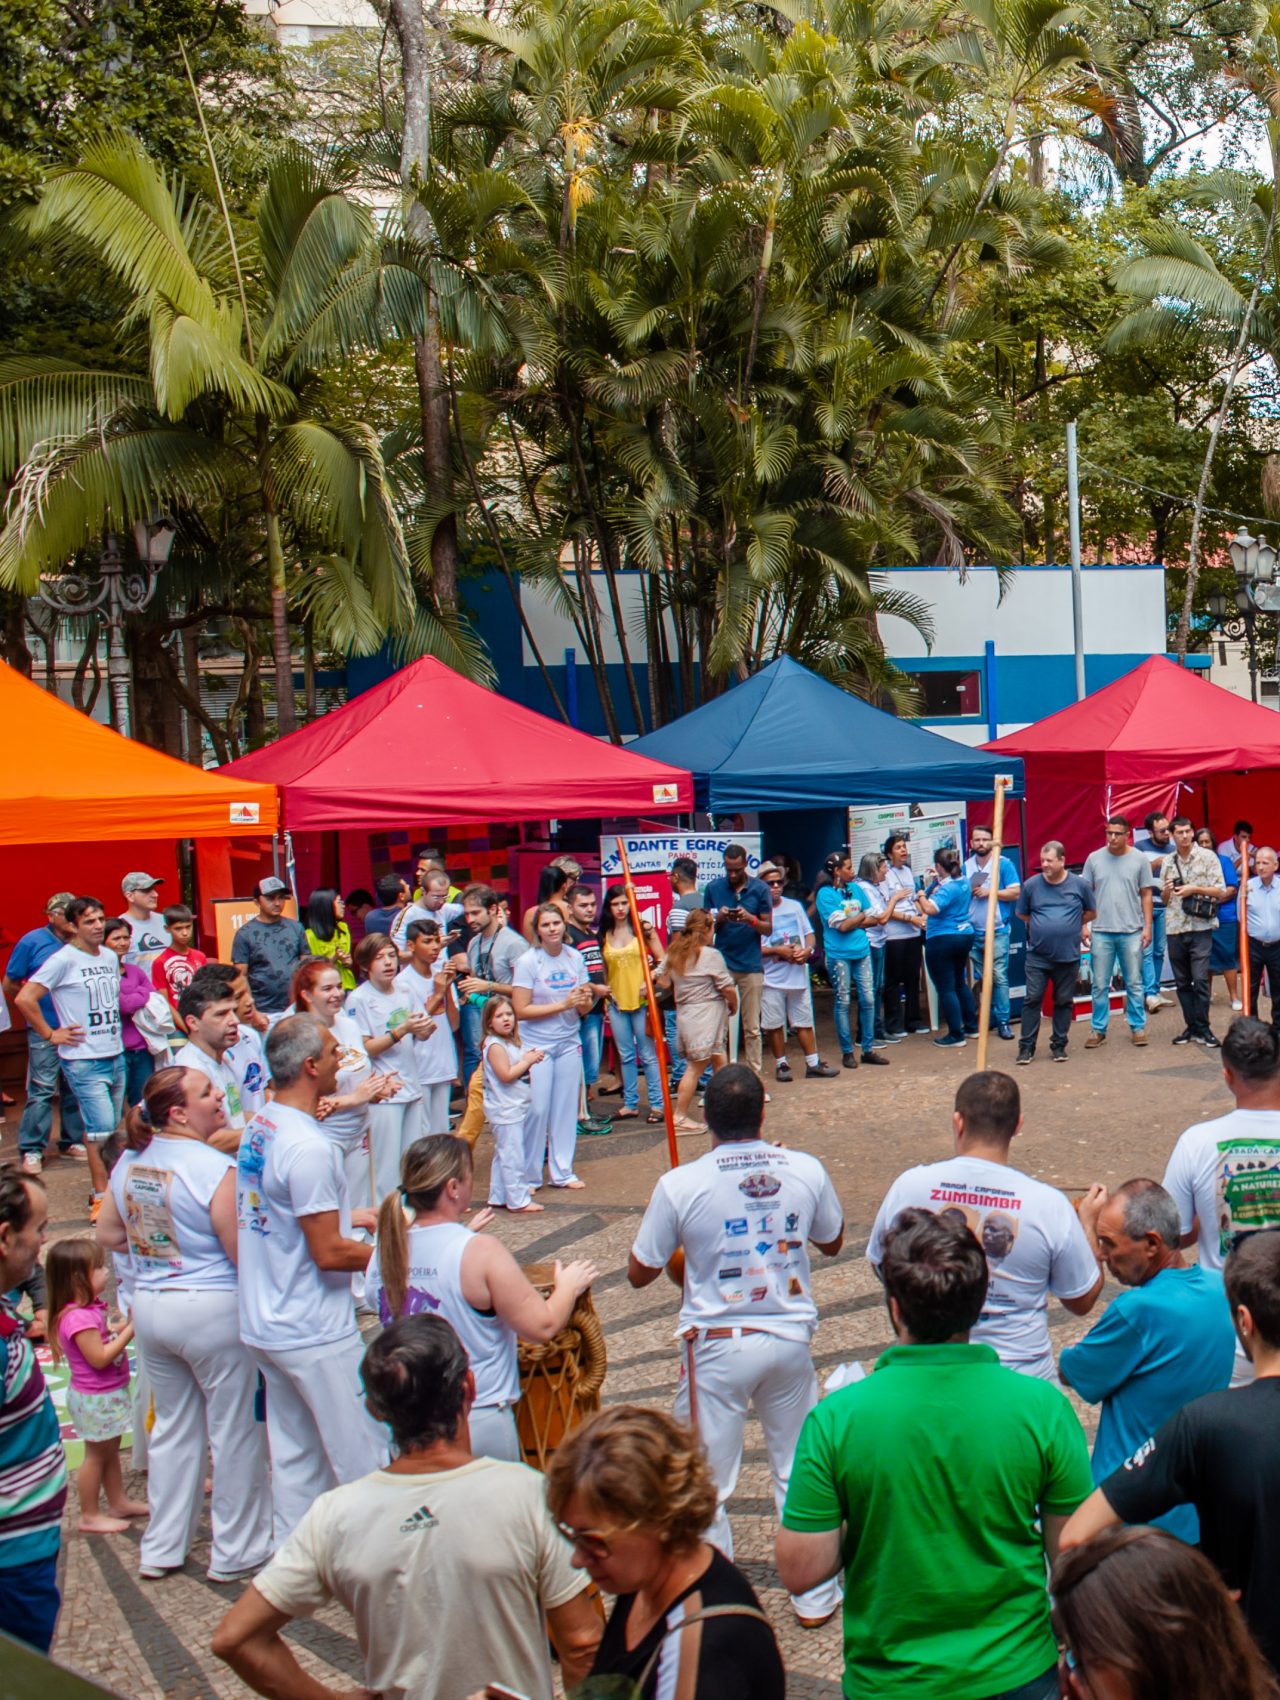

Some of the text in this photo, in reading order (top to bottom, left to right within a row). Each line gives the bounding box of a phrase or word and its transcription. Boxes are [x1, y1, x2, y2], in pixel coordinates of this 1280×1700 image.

[628, 839, 679, 852] DANTE
[629, 861, 662, 870] LANTAS
[88, 1009, 120, 1027] DIA
[930, 1189, 1022, 1211] ZUMBIMBA
[408, 1266, 438, 1277] POEIRA
[400, 1519, 440, 1533] adidas
